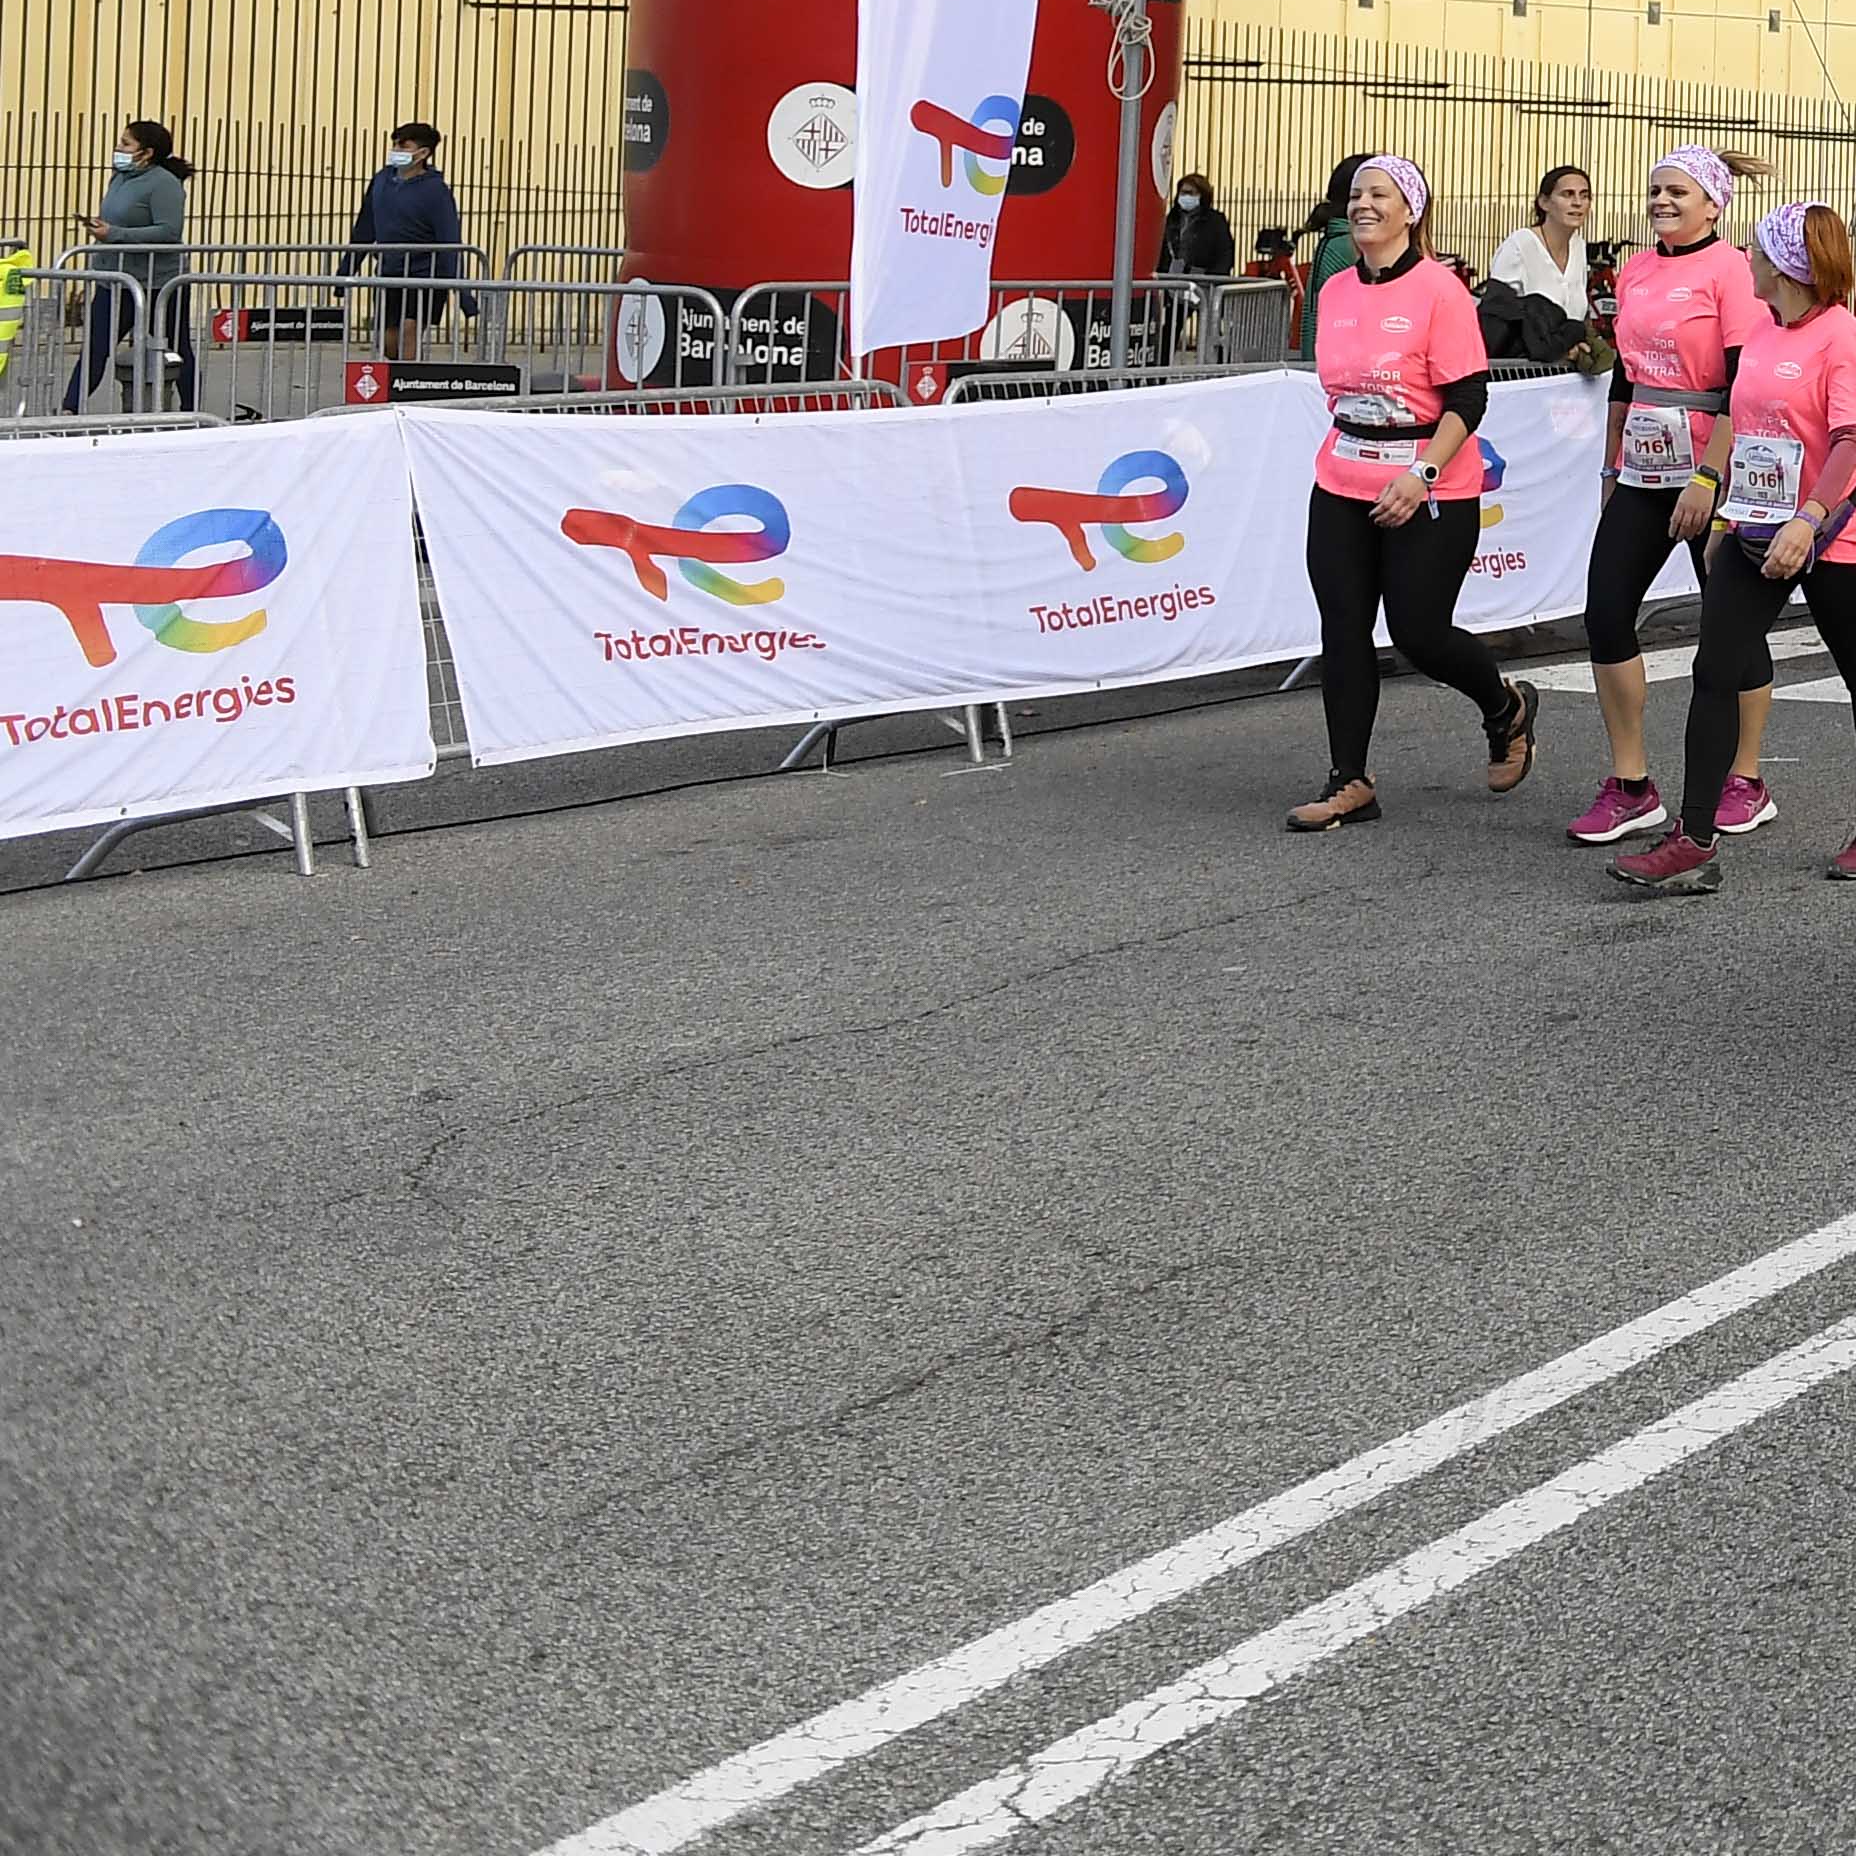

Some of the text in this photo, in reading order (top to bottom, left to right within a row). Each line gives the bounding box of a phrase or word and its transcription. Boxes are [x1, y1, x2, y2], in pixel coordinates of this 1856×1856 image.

[1022, 118, 1046, 136] de
[783, 316, 806, 336] de
[393, 378, 516, 392] Ajuntament de Barcelona
[1635, 439, 1664, 454] 016
[1748, 471, 1777, 488] 016
[1029, 583, 1217, 636] TotalEnergies
[0, 673, 296, 745] TotalEnergies
